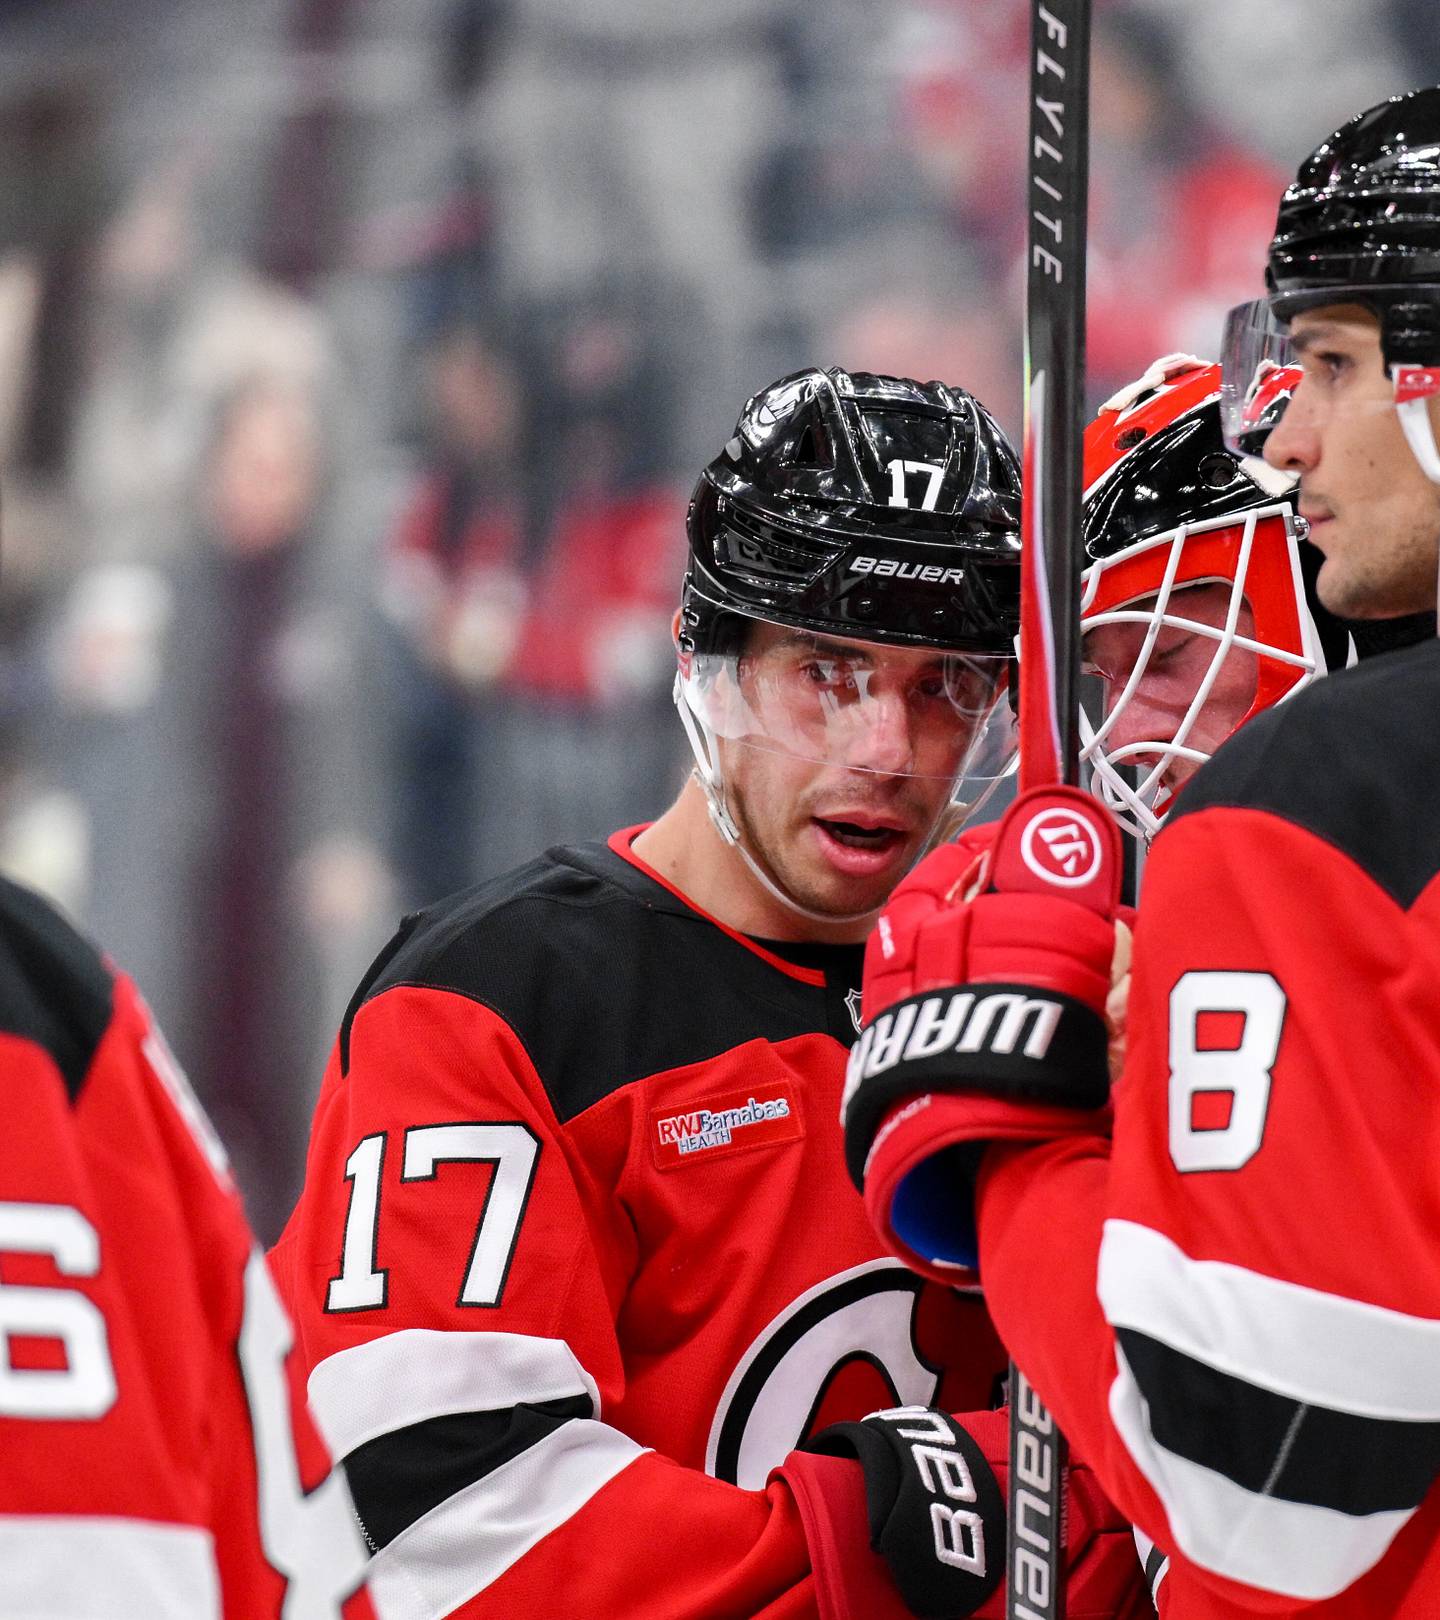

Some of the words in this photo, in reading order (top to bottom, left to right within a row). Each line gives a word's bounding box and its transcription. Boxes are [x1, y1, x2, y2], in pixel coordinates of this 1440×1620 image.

[1033, 3, 1068, 284] FLYLITE
[887, 459, 945, 512] 17
[677, 1129, 731, 1155] HEALTH
[1167, 970, 1287, 1174] 8
[323, 1120, 543, 1314] 17
